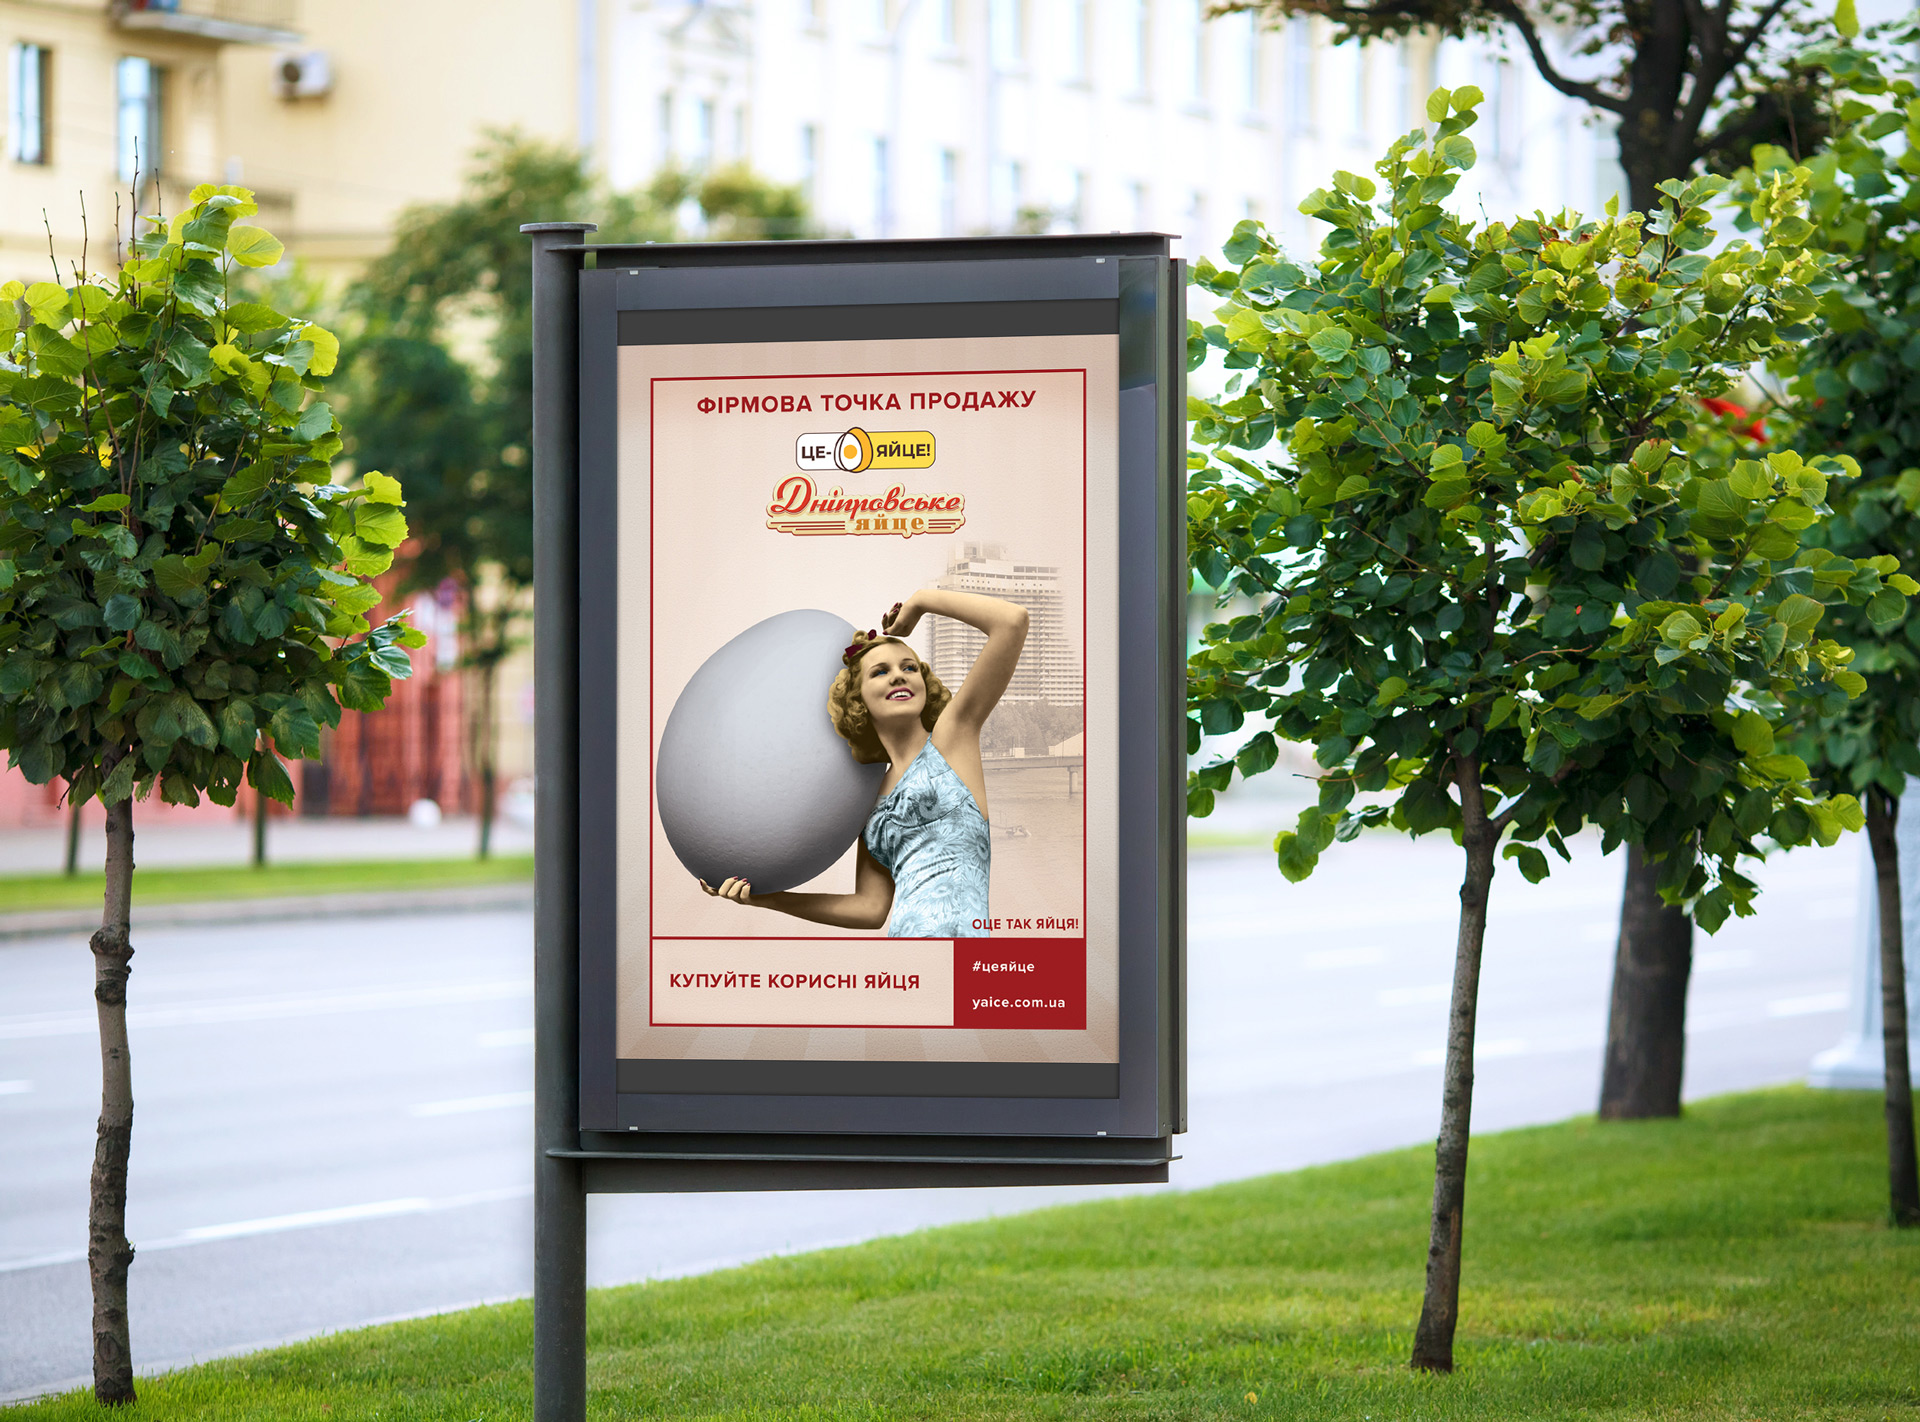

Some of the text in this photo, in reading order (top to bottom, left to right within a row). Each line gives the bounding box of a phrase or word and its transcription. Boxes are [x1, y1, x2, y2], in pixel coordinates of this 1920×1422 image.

[697, 389, 1036, 414] ФІРМОВА ТОЧКА ПРОДАЖУ
[801, 440, 931, 461] ЦЕ- ЯЙЦЕ!
[770, 476, 962, 520] Дніпровське
[855, 513, 925, 534] яйце
[972, 916, 1079, 931] ОЦЕ ТАК ЯЙЦЯ!
[972, 960, 1035, 974] #цеяйце
[670, 971, 920, 990] КУПУЙТЕ КОРИСНІ ЯЙЦЯ
[972, 996, 1065, 1009] yaice.com.ua
